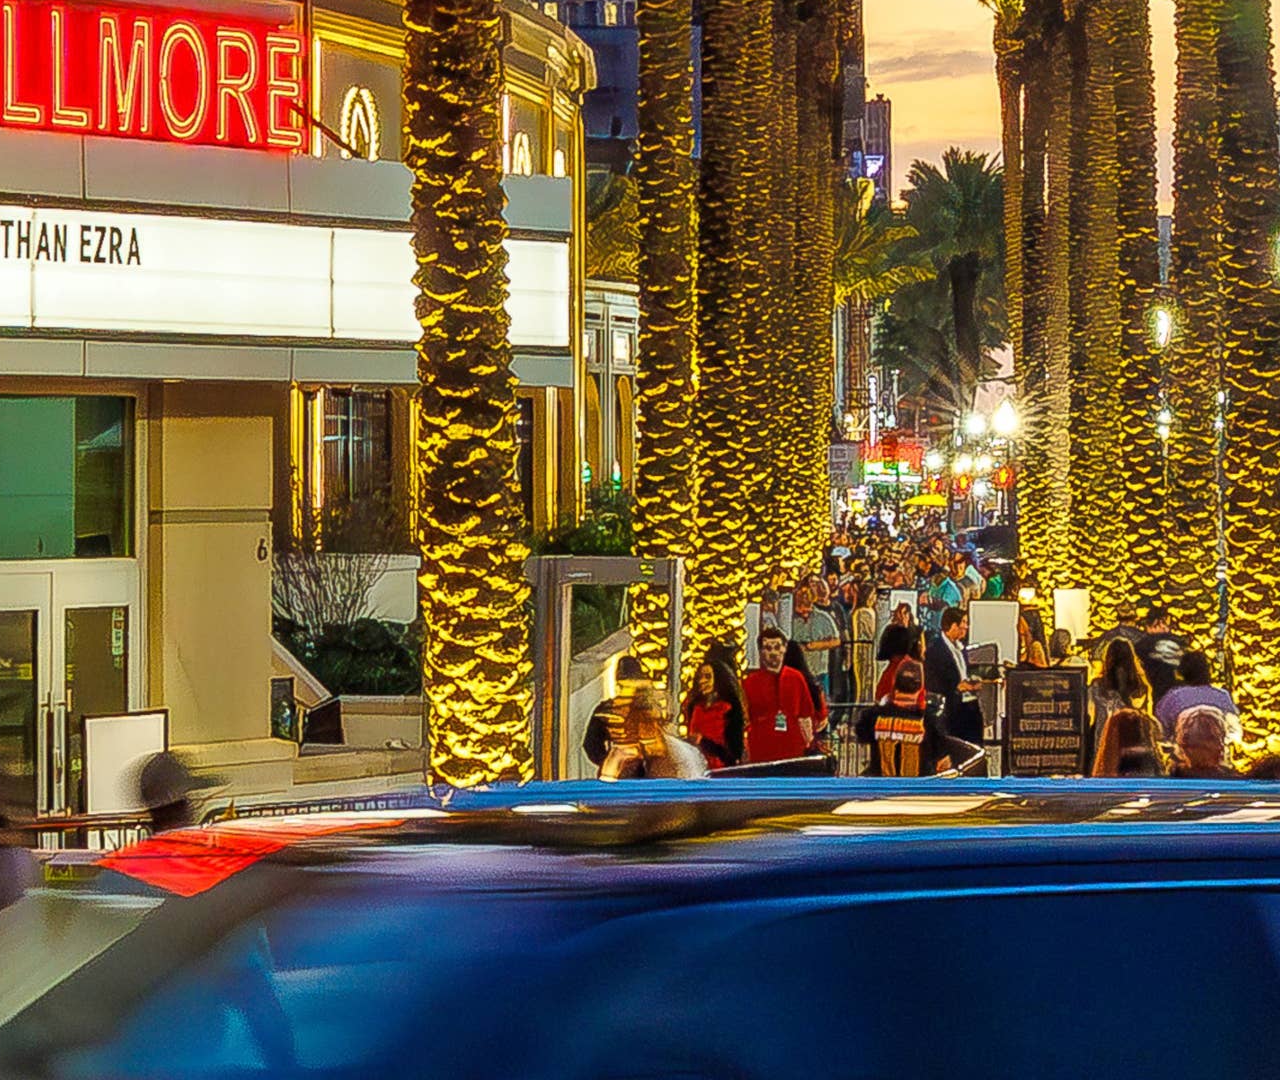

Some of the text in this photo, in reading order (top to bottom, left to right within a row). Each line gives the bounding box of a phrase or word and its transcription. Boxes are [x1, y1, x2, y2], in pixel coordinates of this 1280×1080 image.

[0, 219, 68, 263] THAN
[79, 224, 142, 266] EZRA
[256, 537, 268, 562] 6
